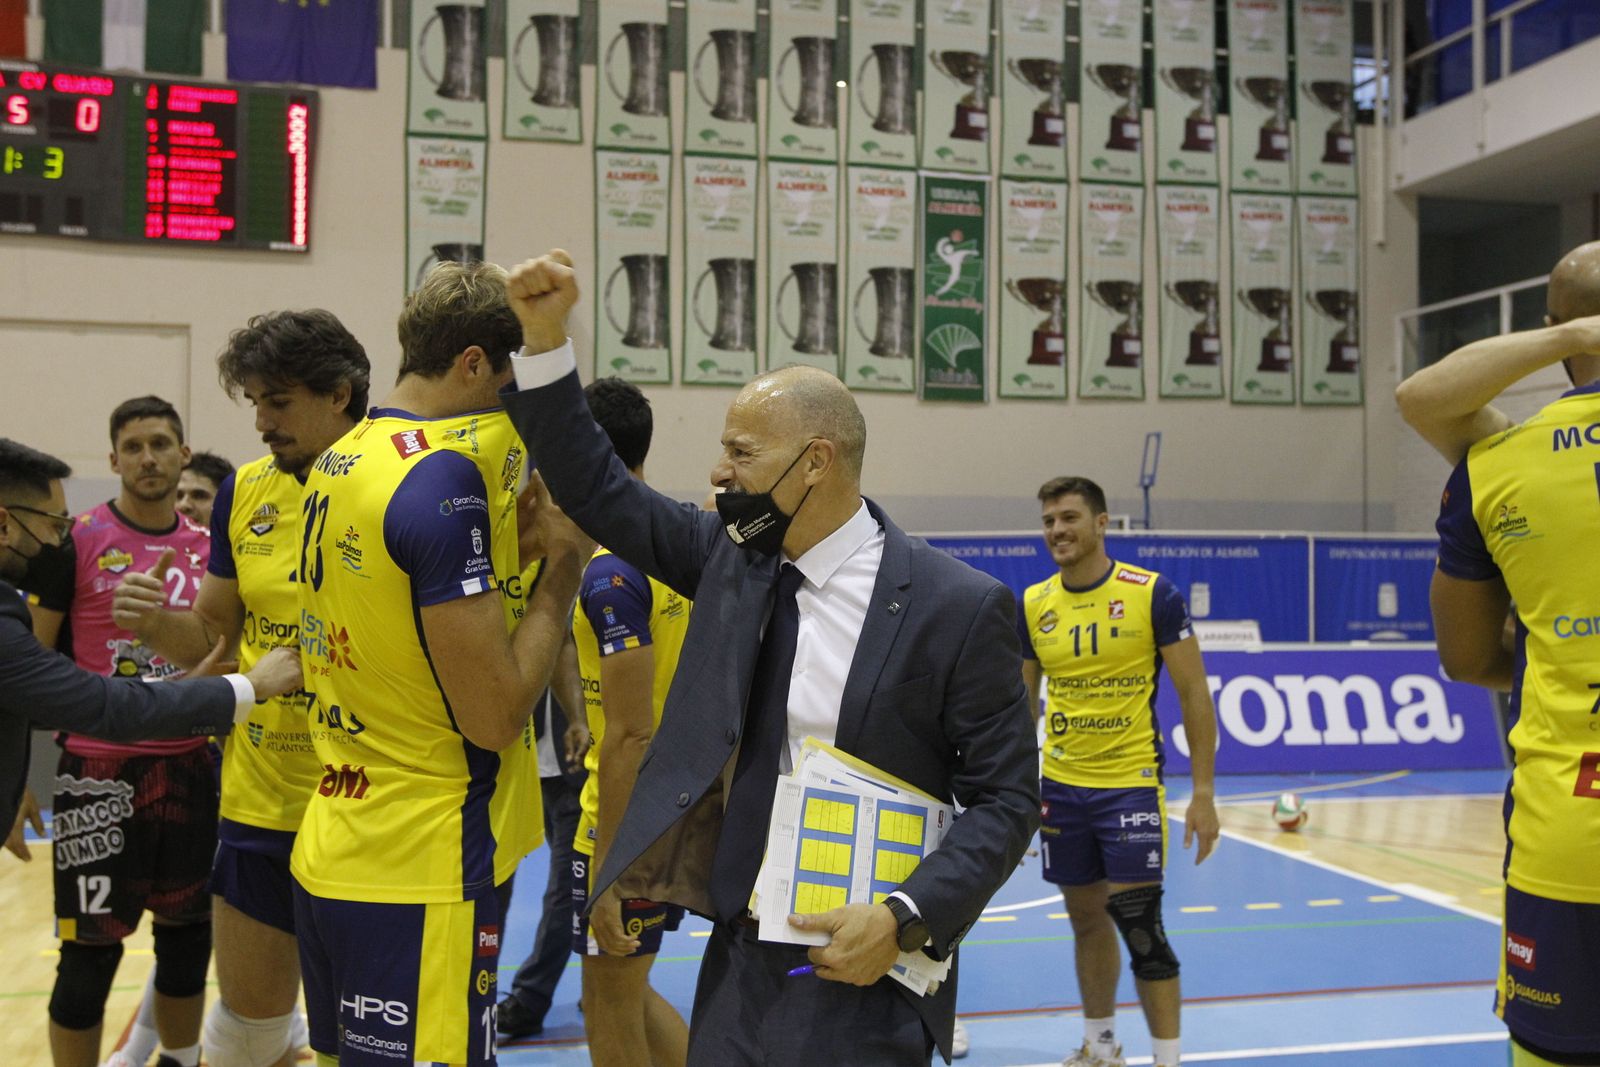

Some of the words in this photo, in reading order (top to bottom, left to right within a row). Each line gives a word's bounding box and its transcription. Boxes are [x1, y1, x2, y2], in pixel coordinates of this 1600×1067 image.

[75, 97, 101, 133] 0
[1119, 569, 1150, 585] Pinay
[1069, 622, 1099, 657] 11
[1070, 716, 1132, 729] GUAGUAS
[1120, 812, 1160, 828] HPS
[56, 827, 124, 870] JUMBO
[77, 875, 112, 914] 12
[340, 990, 409, 1026] HPS
[1515, 983, 1562, 1006] GUAGUAS
[345, 1029, 366, 1045] Gran
[367, 1035, 407, 1052] Canaria
